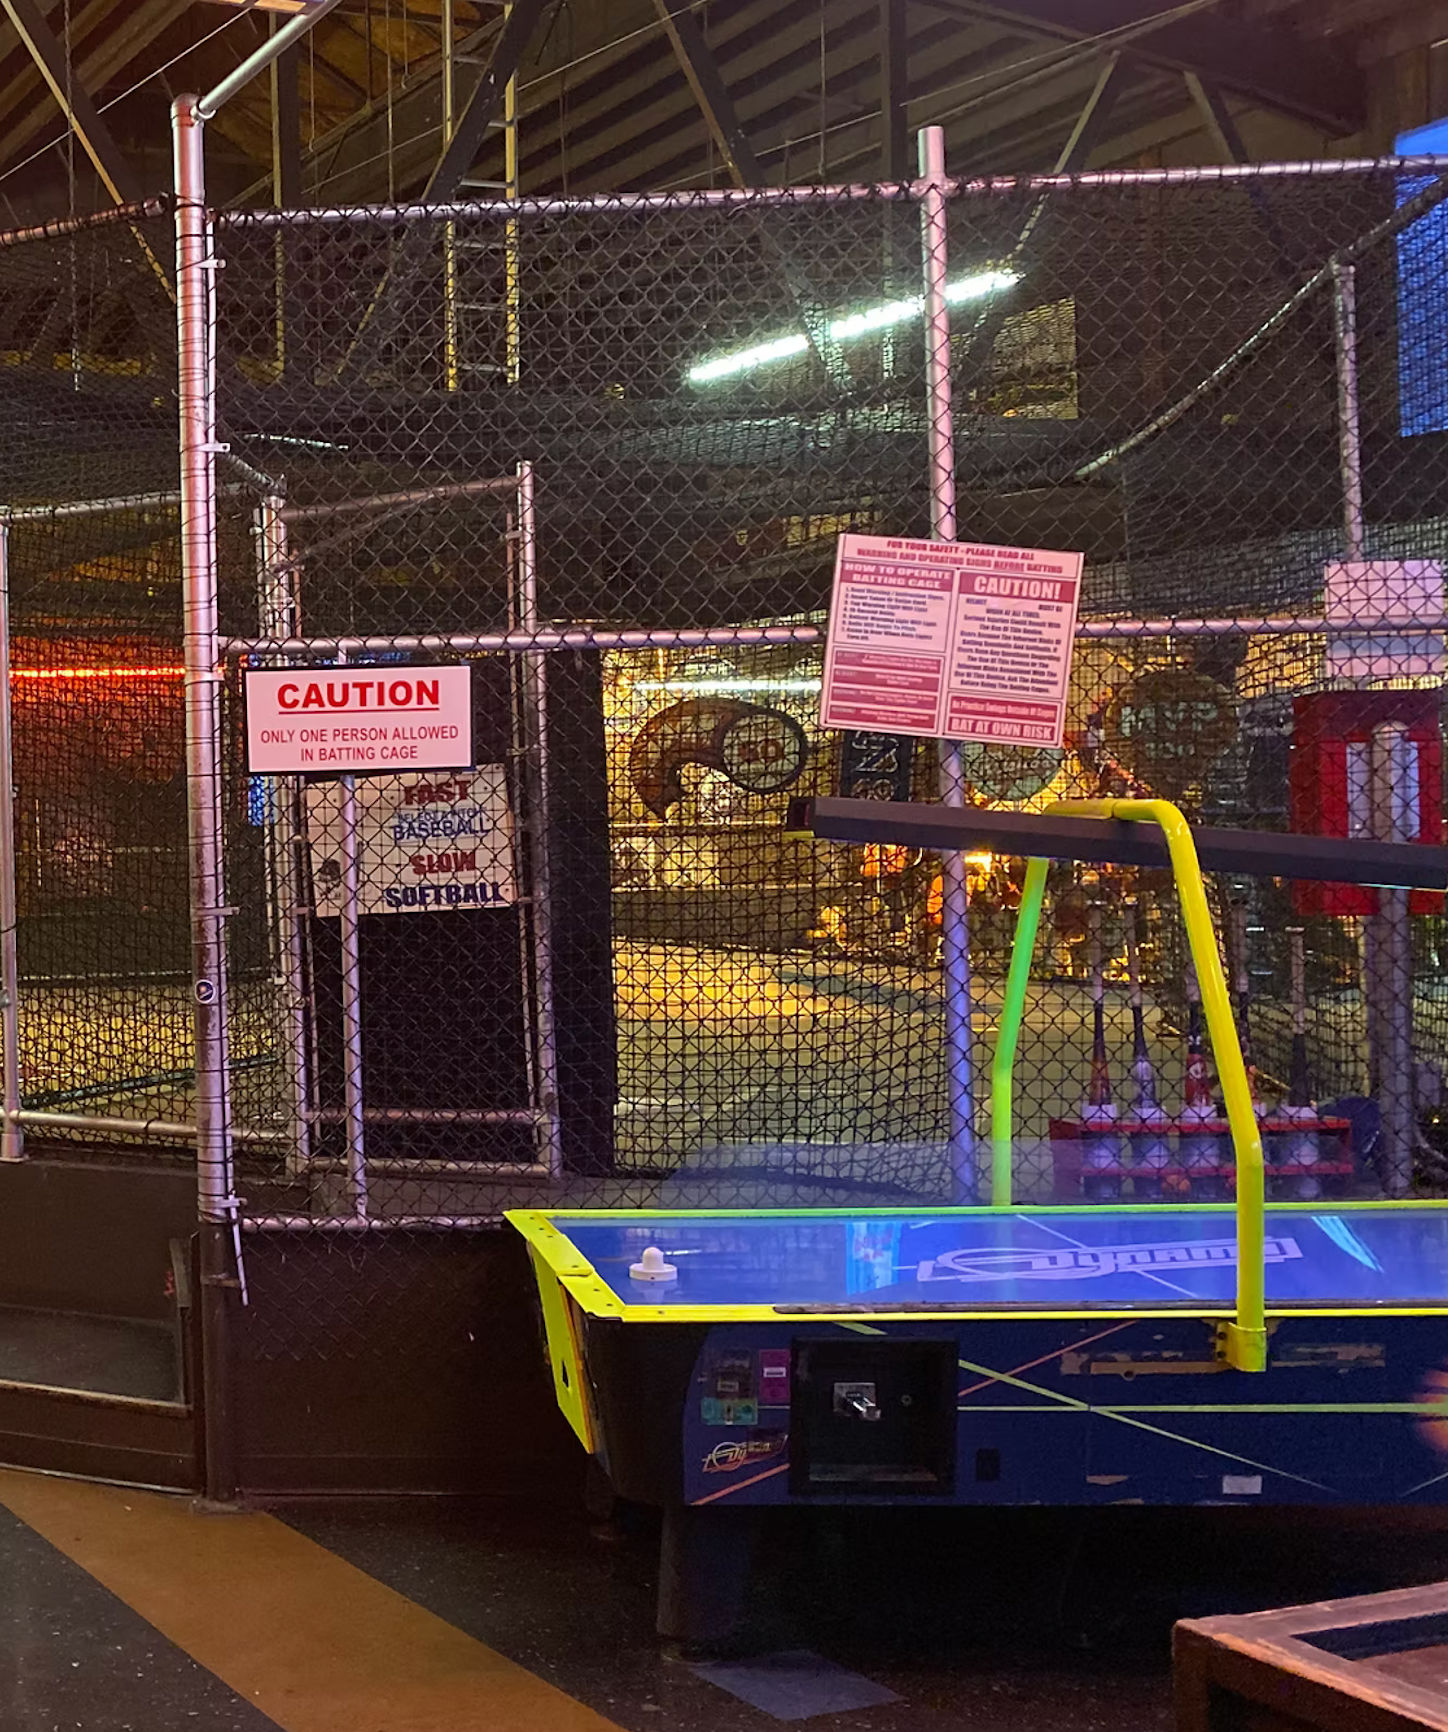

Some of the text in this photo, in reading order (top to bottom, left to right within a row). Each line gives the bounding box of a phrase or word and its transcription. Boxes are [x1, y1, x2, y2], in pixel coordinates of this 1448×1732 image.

[929, 544, 960, 554] SAFETY
[966, 548, 995, 558] PLEASE
[1021, 552, 1034, 560] ALL
[845, 563, 951, 579] HOW TO OPERATE
[918, 554, 964, 565] OPERATING
[994, 560, 1025, 571] BEFORE
[1026, 563, 1063, 574] BATTING
[853, 573, 941, 589] BATTING CAGE
[974, 576, 1062, 599] CAUTION!
[277, 680, 439, 708] CAUTION
[261, 725, 459, 744] ONLY ONE PERSON ALLOWED
[951, 718, 1052, 739] BAT AT OWN RISK
[301, 745, 418, 762] IN BATTING CAGE
[404, 781, 470, 805] FAST
[393, 817, 490, 840] BASEBALL
[409, 851, 476, 875] SLOW
[384, 882, 501, 907] SOFTBALL
